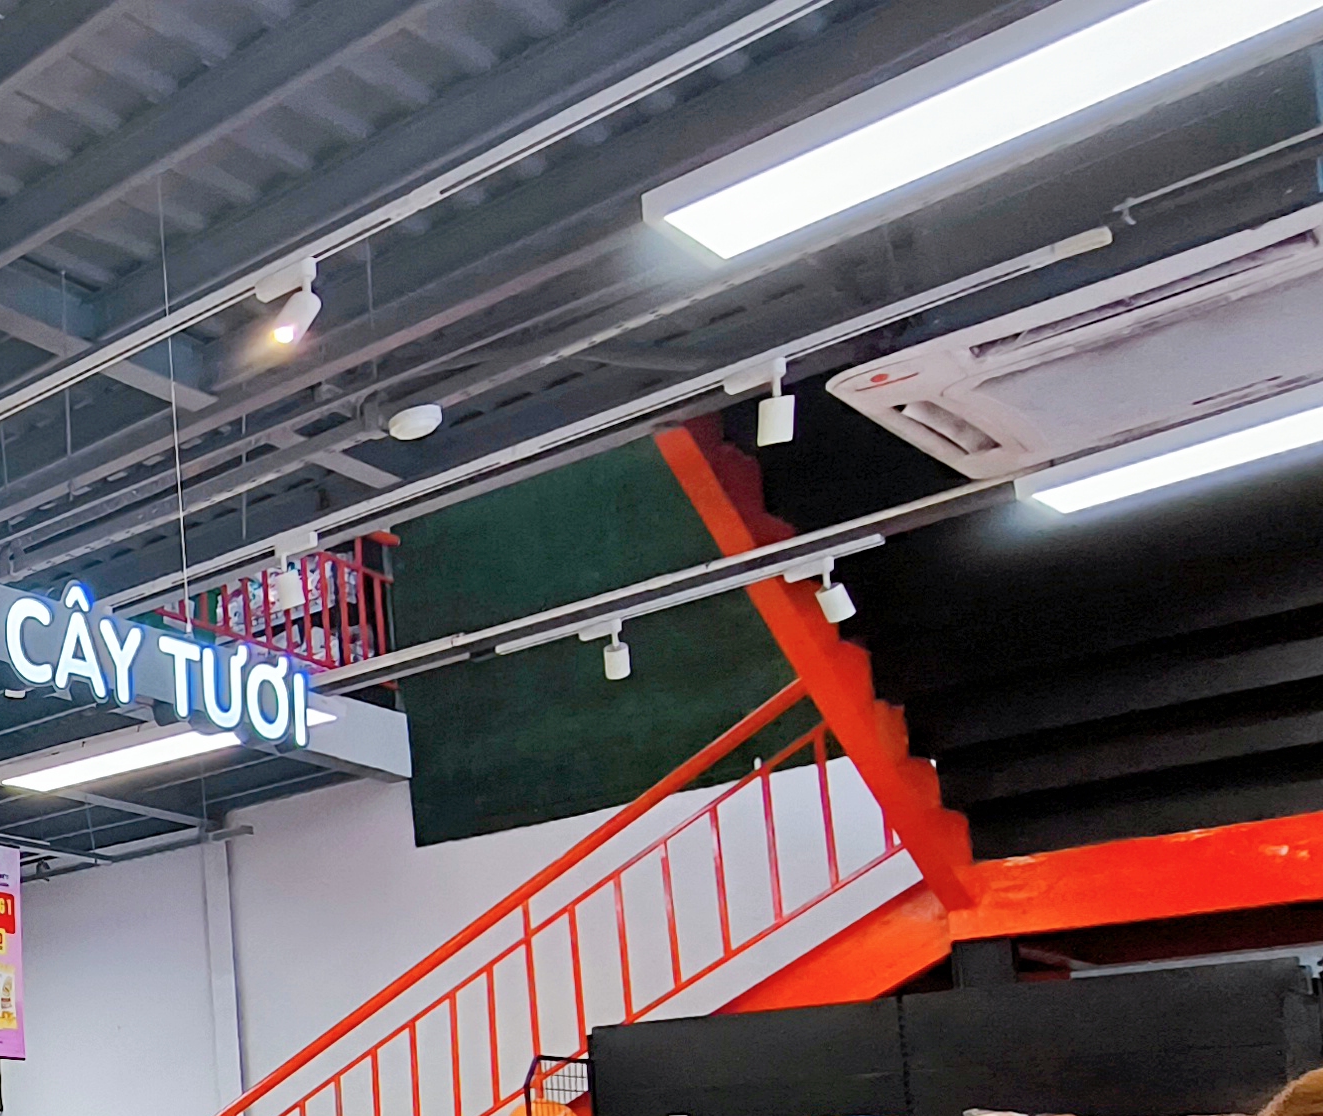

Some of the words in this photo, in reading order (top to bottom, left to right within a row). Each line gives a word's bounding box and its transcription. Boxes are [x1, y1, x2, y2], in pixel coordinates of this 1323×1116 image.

[3, 579, 143, 705] CÂY
[157, 634, 311, 748] TƯƠI
[6, 899, 12, 916] 1
